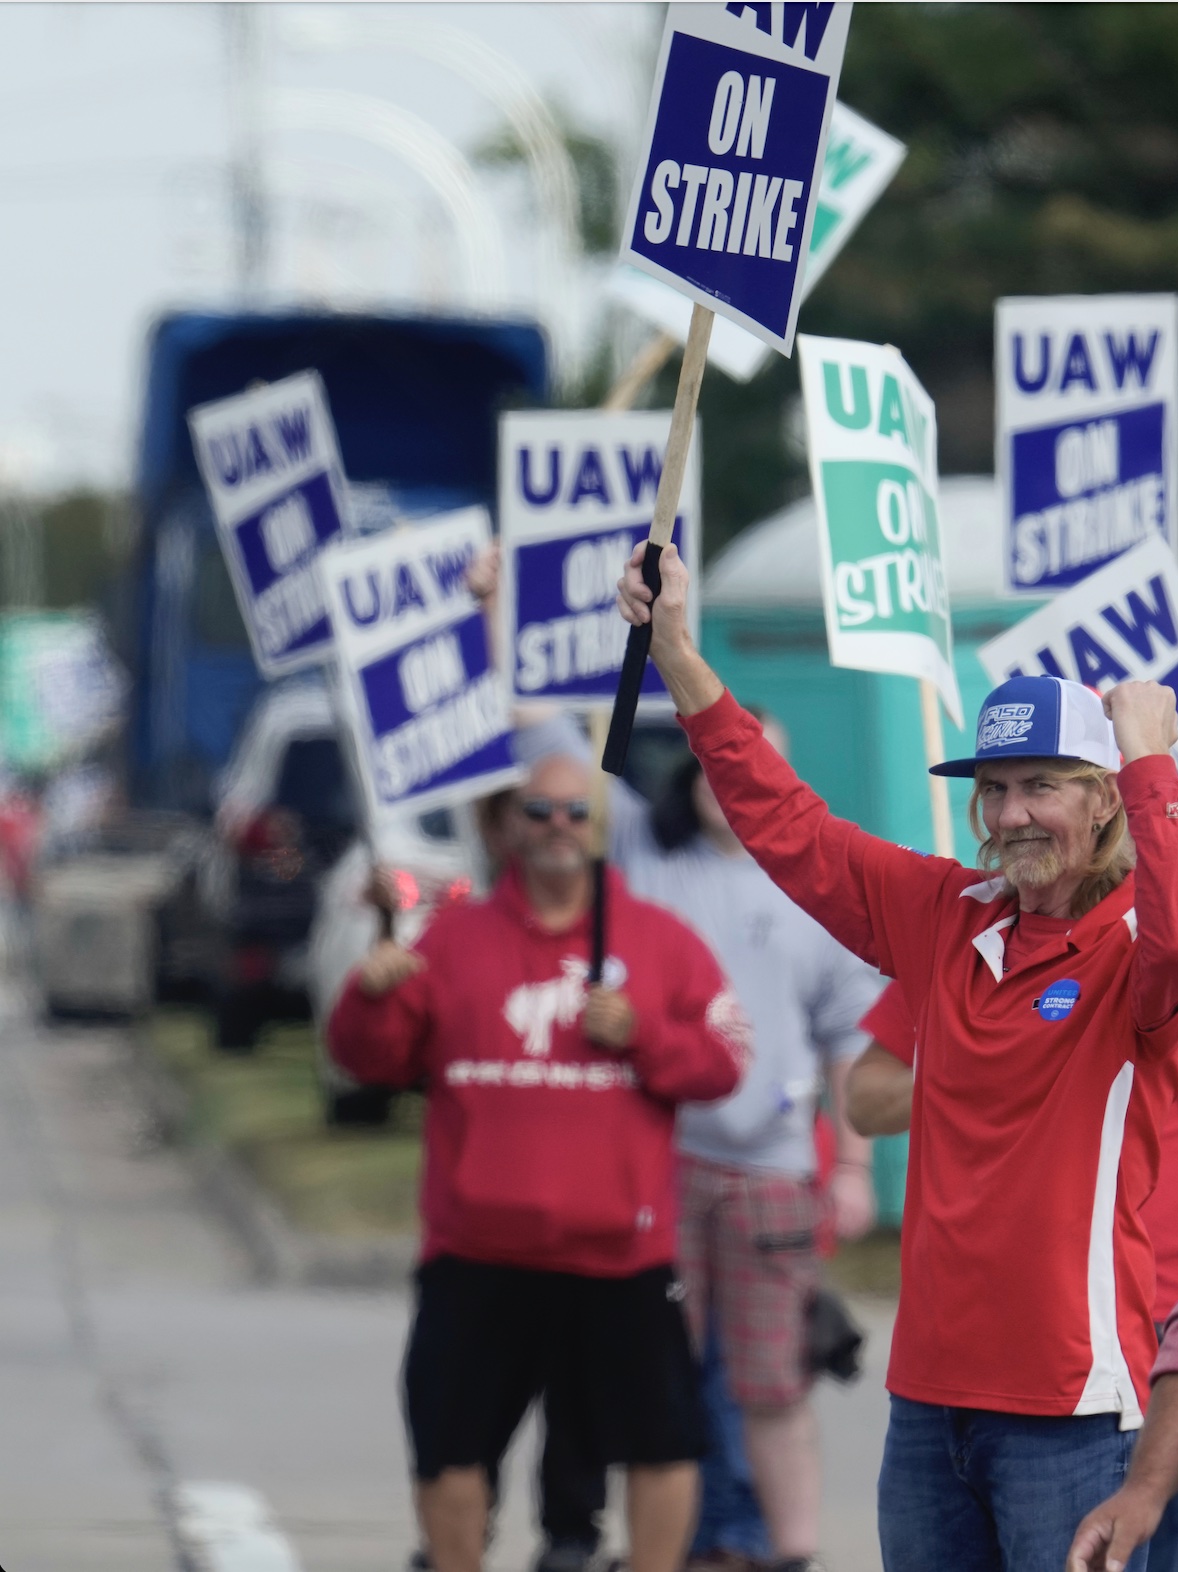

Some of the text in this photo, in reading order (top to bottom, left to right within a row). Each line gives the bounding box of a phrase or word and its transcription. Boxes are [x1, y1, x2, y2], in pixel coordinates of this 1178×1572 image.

[706, 70, 776, 160] ON
[643, 158, 804, 263] STRIKE
[1011, 329, 1161, 394] UAW
[208, 406, 311, 487] UAW
[1054, 418, 1120, 499] ON
[1013, 470, 1164, 586] STRIKE
[339, 541, 474, 629] UAW
